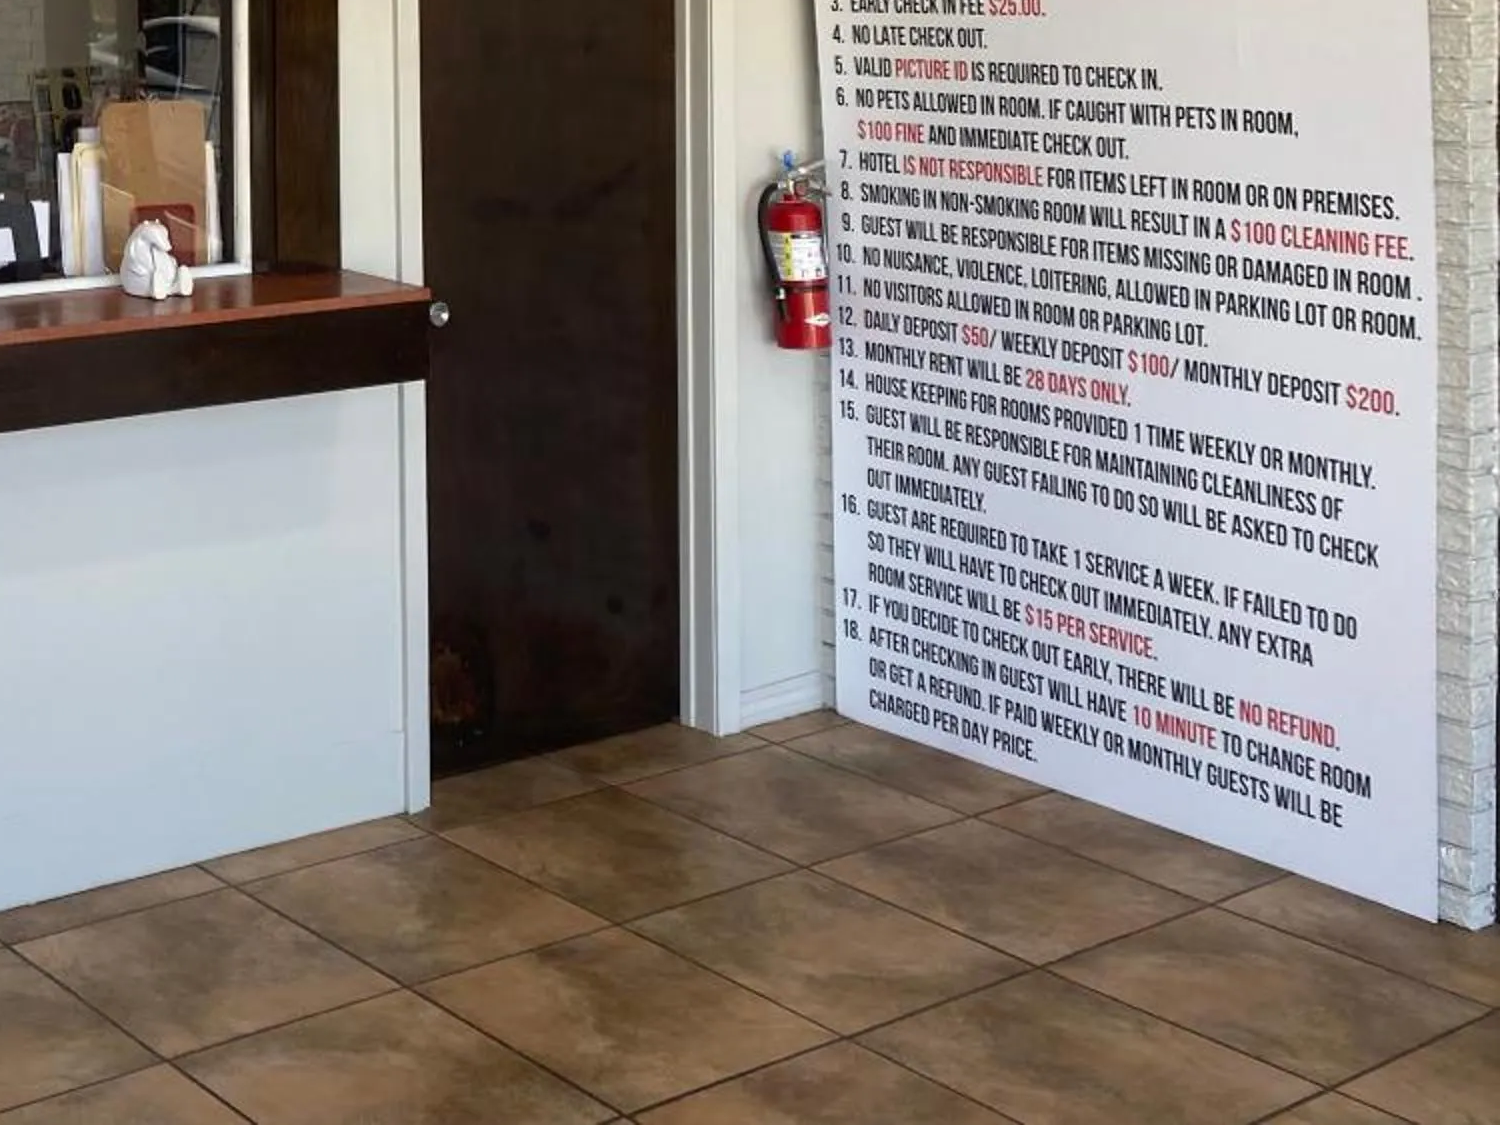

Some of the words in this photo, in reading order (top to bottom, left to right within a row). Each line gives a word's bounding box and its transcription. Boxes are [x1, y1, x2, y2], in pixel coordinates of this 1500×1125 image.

[852, 54, 893, 78] VALID
[894, 56, 951, 81] PICTURE
[952, 59, 969, 82] ID
[970, 59, 985, 83] IS
[987, 60, 1062, 87] REQUIRED
[1061, 64, 1082, 88] TO
[1084, 65, 1138, 91] CHECK
[854, 85, 875, 108] NO
[876, 86, 910, 111] PETS
[911, 89, 977, 115] ALLOWED
[979, 93, 995, 117] IN
[1047, 97, 1063, 121] IF
[1064, 98, 1127, 126] CAUGHT
[1128, 102, 1171, 129] WITH
[1174, 104, 1217, 132] PETS
[1220, 107, 1238, 134] IN
[856, 117, 893, 141] $100
[894, 120, 925, 144] FINE
[927, 122, 957, 147] AND
[958, 125, 1040, 154] IMMEDIATE
[1041, 131, 1093, 158] CHECK
[858, 148, 900, 174] HOTEL
[902, 152, 916, 175] IS
[918, 153, 945, 178] NOT
[948, 156, 1044, 188] RESPONSIBLE
[1046, 165, 1076, 191] FOR
[1078, 168, 1127, 196] ITEMS
[1129, 172, 1168, 200] LEFT
[1170, 176, 1189, 202] IN
[1191, 178, 1241, 208] ROOM
[1245, 183, 1269, 210] OR
[1272, 185, 1298, 213] ON
[859, 179, 921, 208] SMOKING
[922, 186, 937, 210] IN
[939, 187, 1040, 222] NON-SMOKING
[1042, 198, 1087, 227] ROOM
[1088, 203, 1127, 232] WILL
[1129, 207, 1190, 239] RESULT
[1192, 214, 1211, 241] IN
[1213, 216, 1227, 243] A
[1230, 218, 1277, 249] $100
[1279, 223, 1370, 259] CLEANING
[862, 242, 881, 267] NO
[1114, 276, 1191, 312] ALLOWED
[1193, 286, 1212, 315] IN
[1214, 289, 1291, 326] PARKING
[1294, 300, 1328, 331] LOT
[1327, 304, 1357, 335] OR
[863, 305, 901, 334] DAILY
[902, 312, 959, 344] DEPOSIT
[1000, 328, 1059, 361] WEEKLY
[1060, 337, 1125, 373] DEPOSIT
[1183, 357, 1263, 397] MONTHLY
[1266, 371, 1342, 410] DEPOSIT
[864, 338, 927, 371] MONTHLY
[928, 349, 965, 378] RENT
[966, 356, 1001, 385] WILL
[1002, 362, 1023, 389] BE
[1024, 366, 1045, 393] 28
[1046, 370, 1087, 401] DAYS
[864, 400, 907, 431] GUEST
[909, 409, 942, 439] WILL
[944, 416, 962, 443] BE
[964, 420, 1061, 464] RESPONSIBLE
[1062, 440, 1092, 471] FOR
[1094, 447, 1199, 494] MAINTAINING
[1200, 469, 1317, 520] CLEANLINESS
[1320, 493, 1344, 525] OF
[867, 558, 906, 591] ROOM
[907, 569, 964, 608] SERVICE
[965, 586, 1000, 618] WILL
[1002, 596, 1021, 624] BE
[1024, 602, 1053, 633] $15
[1056, 611, 1086, 643] PER
[868, 621, 909, 656] AFTER
[911, 634, 979, 678] CHECKING
[980, 655, 997, 684] IN
[998, 661, 1045, 699] GUEST
[1047, 676, 1083, 711] WILL
[1086, 688, 1127, 725] HAVE
[1133, 702, 1152, 732] 10
[1155, 709, 1219, 754] MINUTE
[1220, 728, 1243, 761] TO
[1245, 736, 1316, 784] CHANGE
[1318, 759, 1371, 802] ROOM
